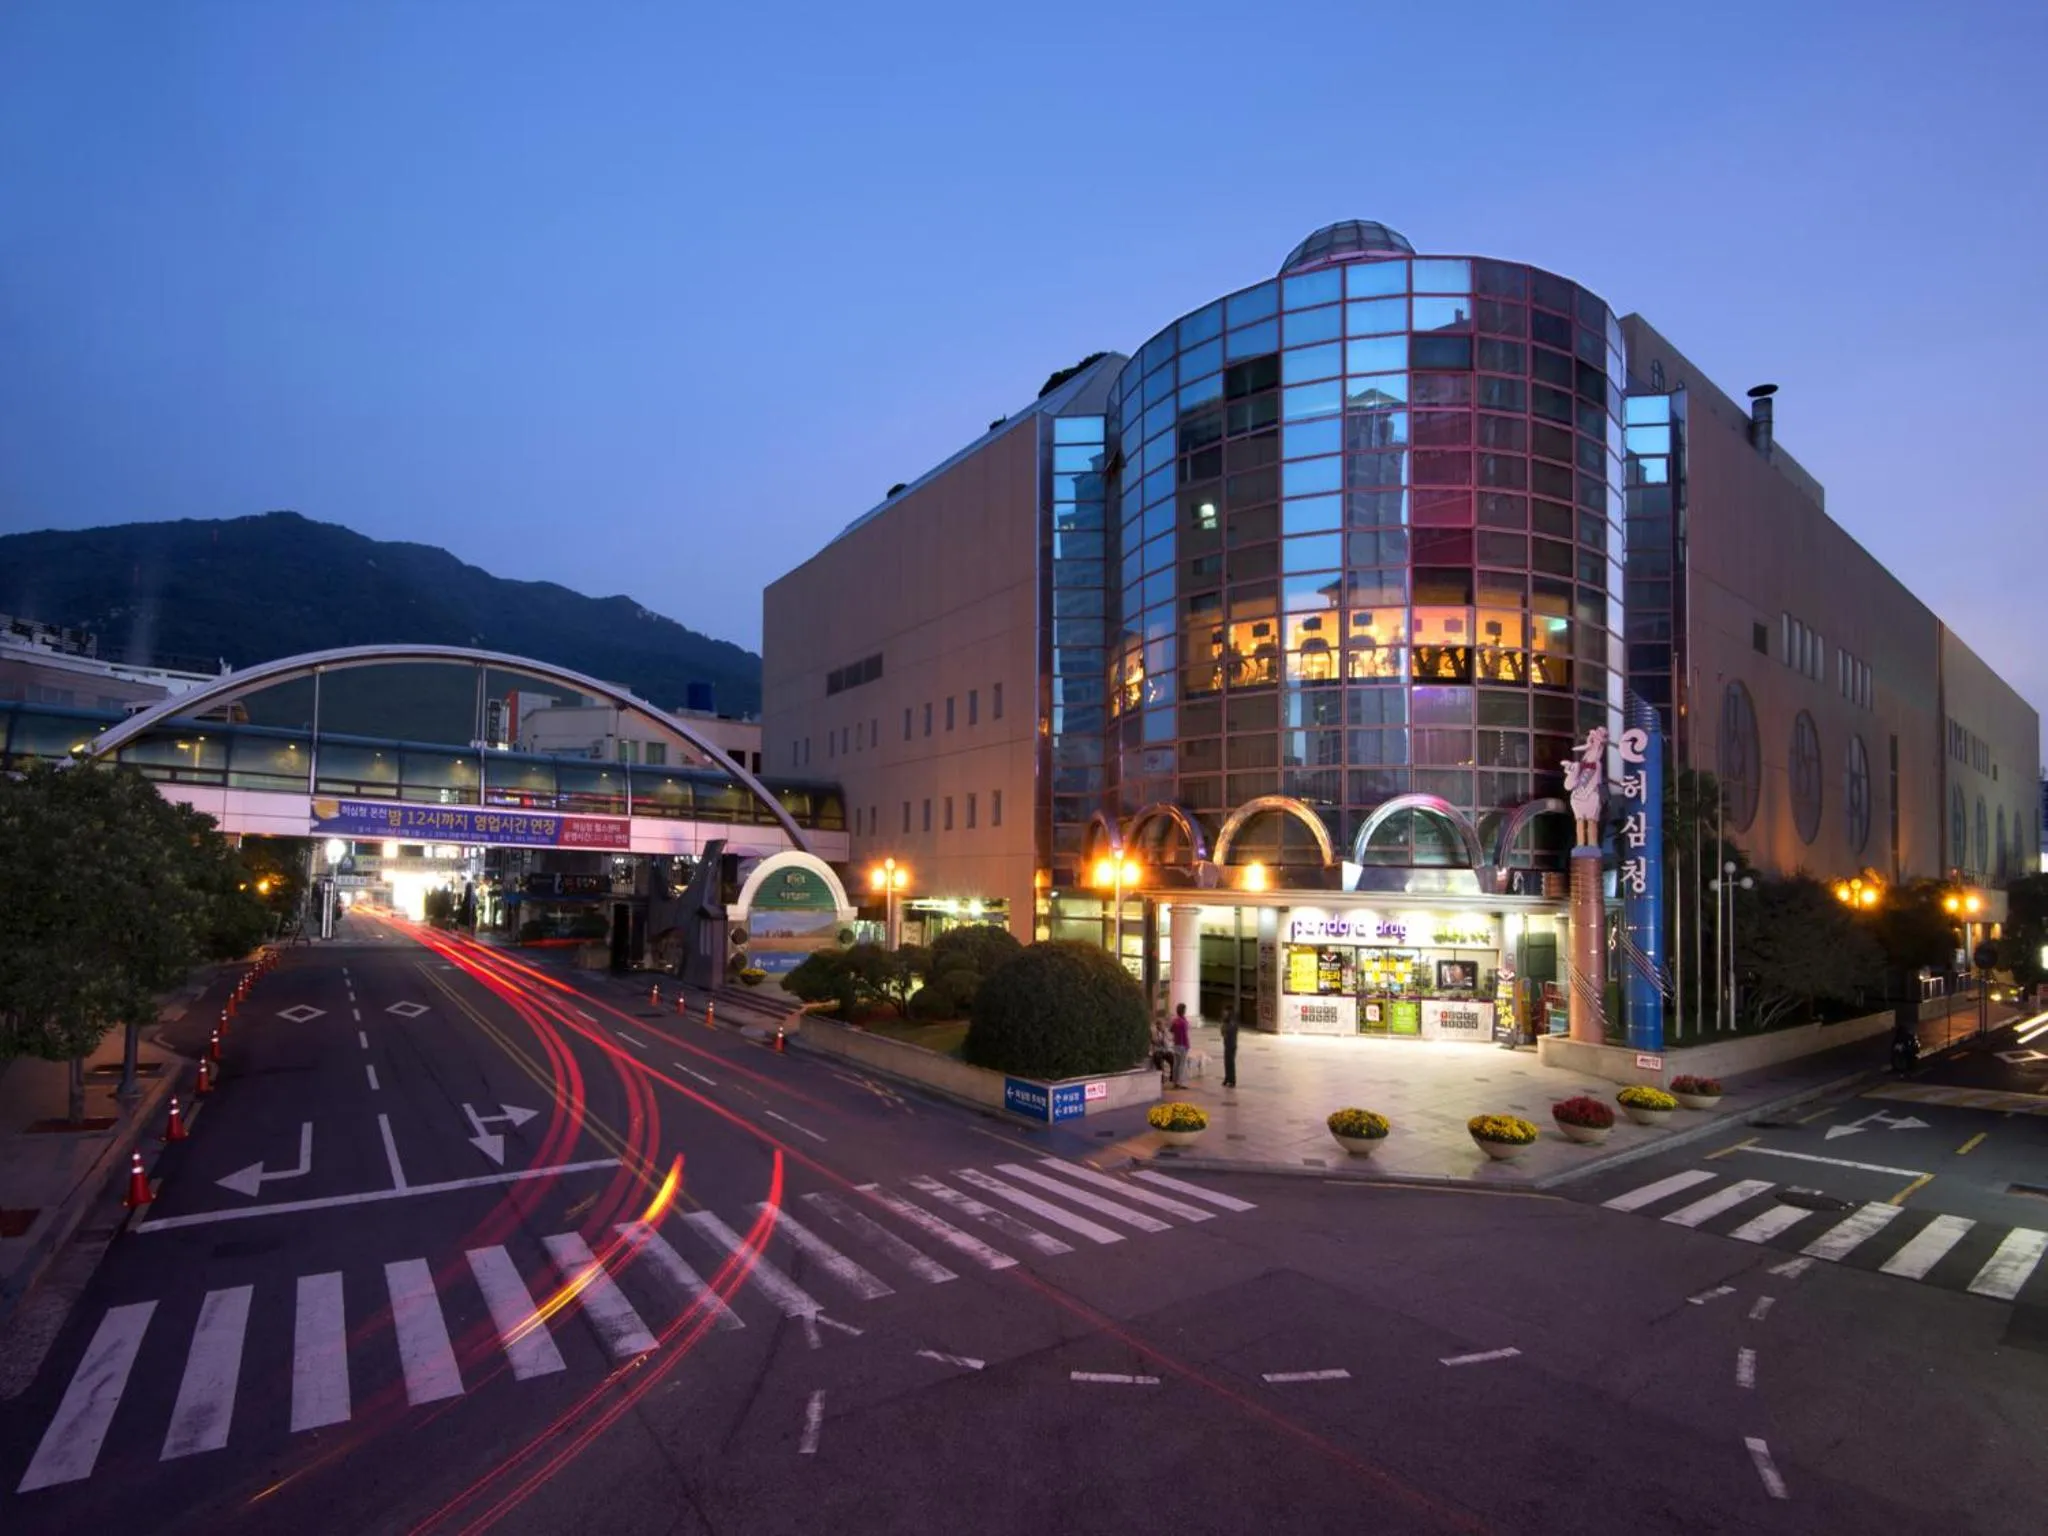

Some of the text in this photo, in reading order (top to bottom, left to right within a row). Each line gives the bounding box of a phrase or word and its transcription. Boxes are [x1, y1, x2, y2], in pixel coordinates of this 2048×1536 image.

[407, 811, 468, 831] 12시까지
[474, 815, 527, 834] 영업시간
[531, 818, 556, 836] 연장
[1620, 770, 1646, 893] 허심청
[1376, 916, 1407, 944] drug
